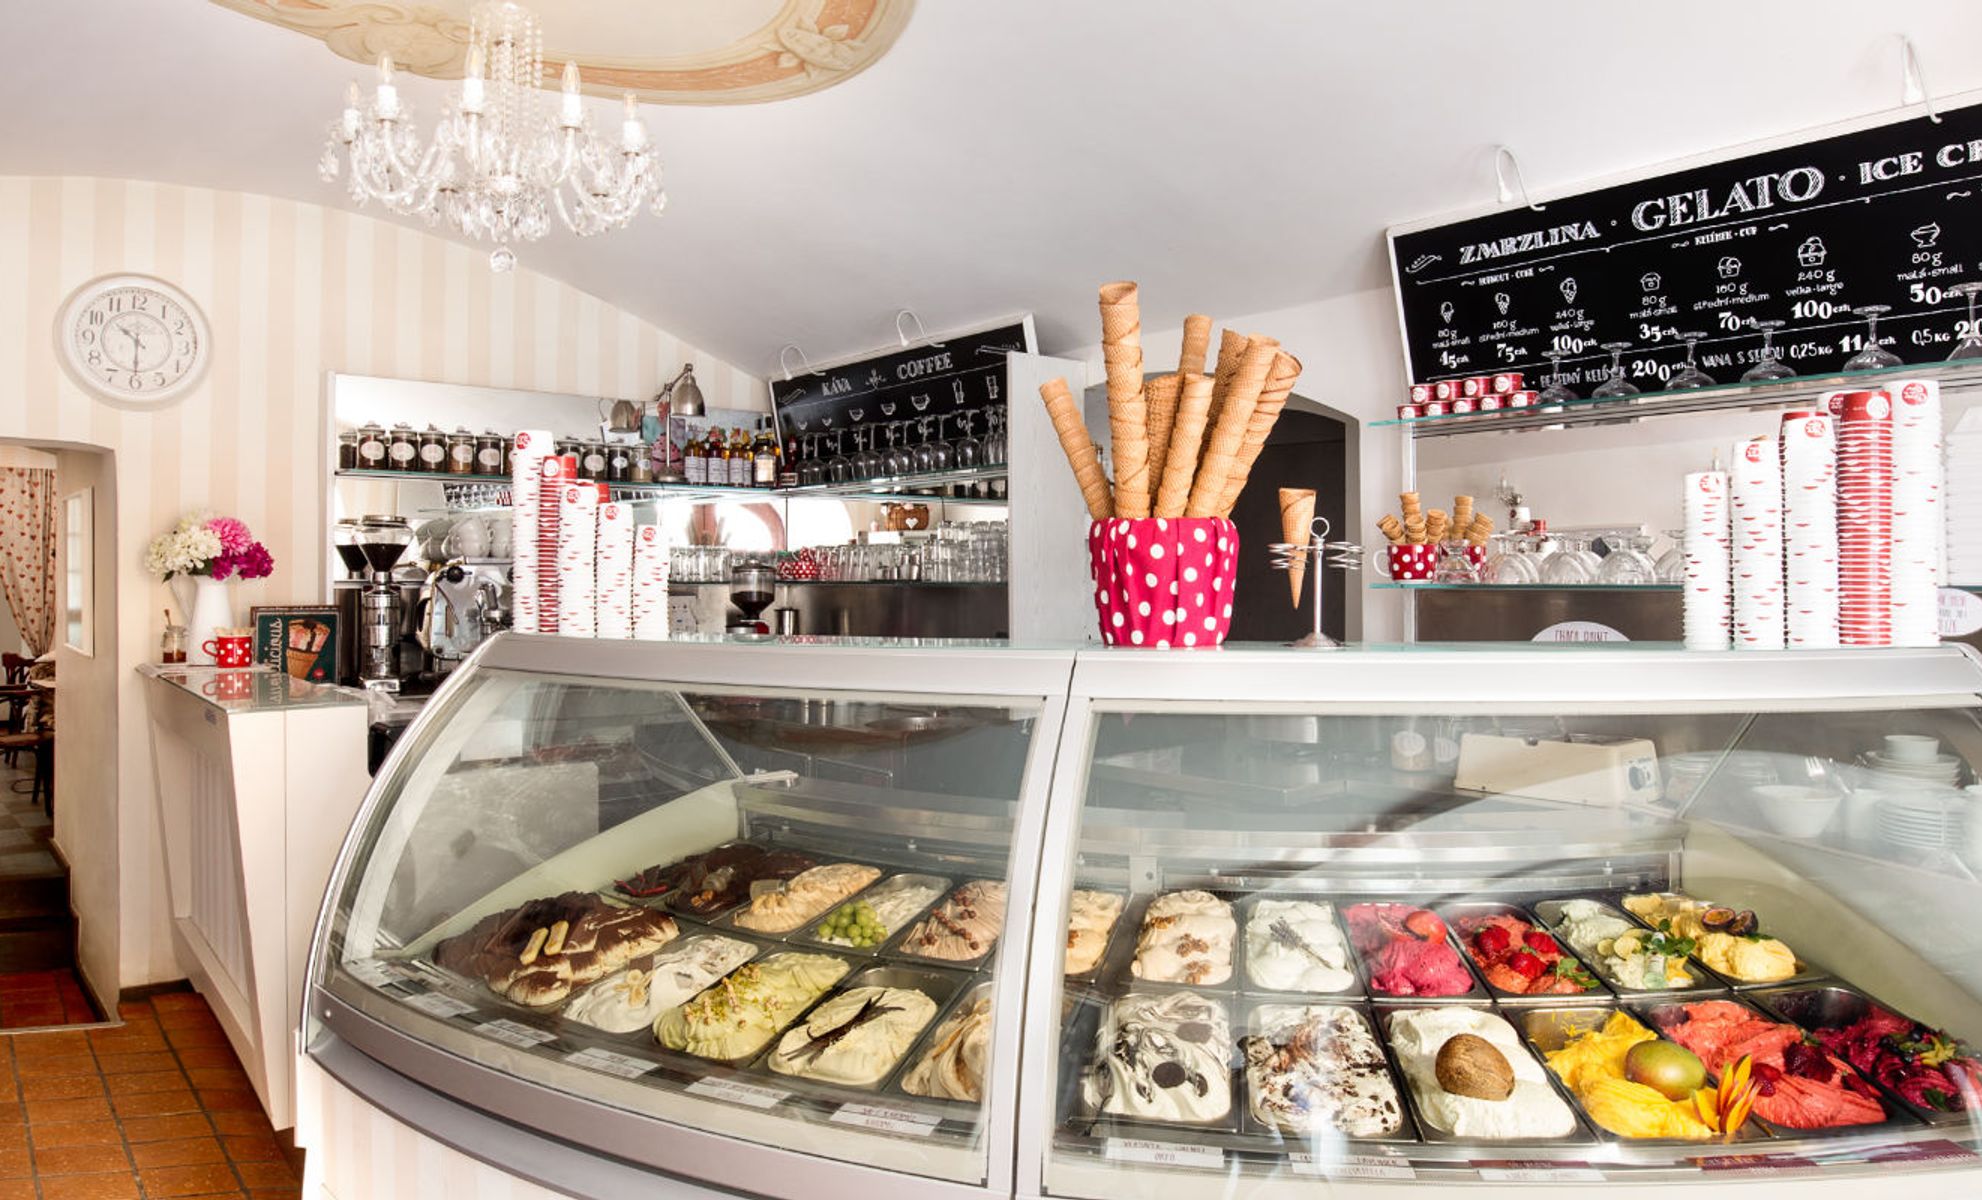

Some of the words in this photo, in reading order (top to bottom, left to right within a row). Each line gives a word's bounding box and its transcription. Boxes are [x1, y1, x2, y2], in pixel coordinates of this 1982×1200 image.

[1459, 221, 1601, 265] ZMRZLINA
[1631, 166, 1825, 232] GELATO
[1858, 152, 1923, 185] ICE
[1912, 252, 1930, 263] 80
[1932, 251, 1943, 267] g
[1797, 269, 1823, 282] 240
[1825, 269, 1836, 282] g
[1715, 283, 1735, 294] 160
[1739, 282, 1749, 295] g
[109, 297, 121, 313] 11
[131, 294, 148, 311] 12
[1641, 295, 1657, 306] 80
[1659, 295, 1667, 308] g
[89, 310, 104, 325] 10
[161, 304, 167, 320] 1
[82, 329, 95, 345] 9
[174, 320, 185, 336] 2
[88, 350, 101, 366] 8
[897, 352, 953, 380] COFFEE
[129, 375, 142, 390] 6
[153, 372, 166, 387] 5
[821, 376, 851, 397] KÁVA
